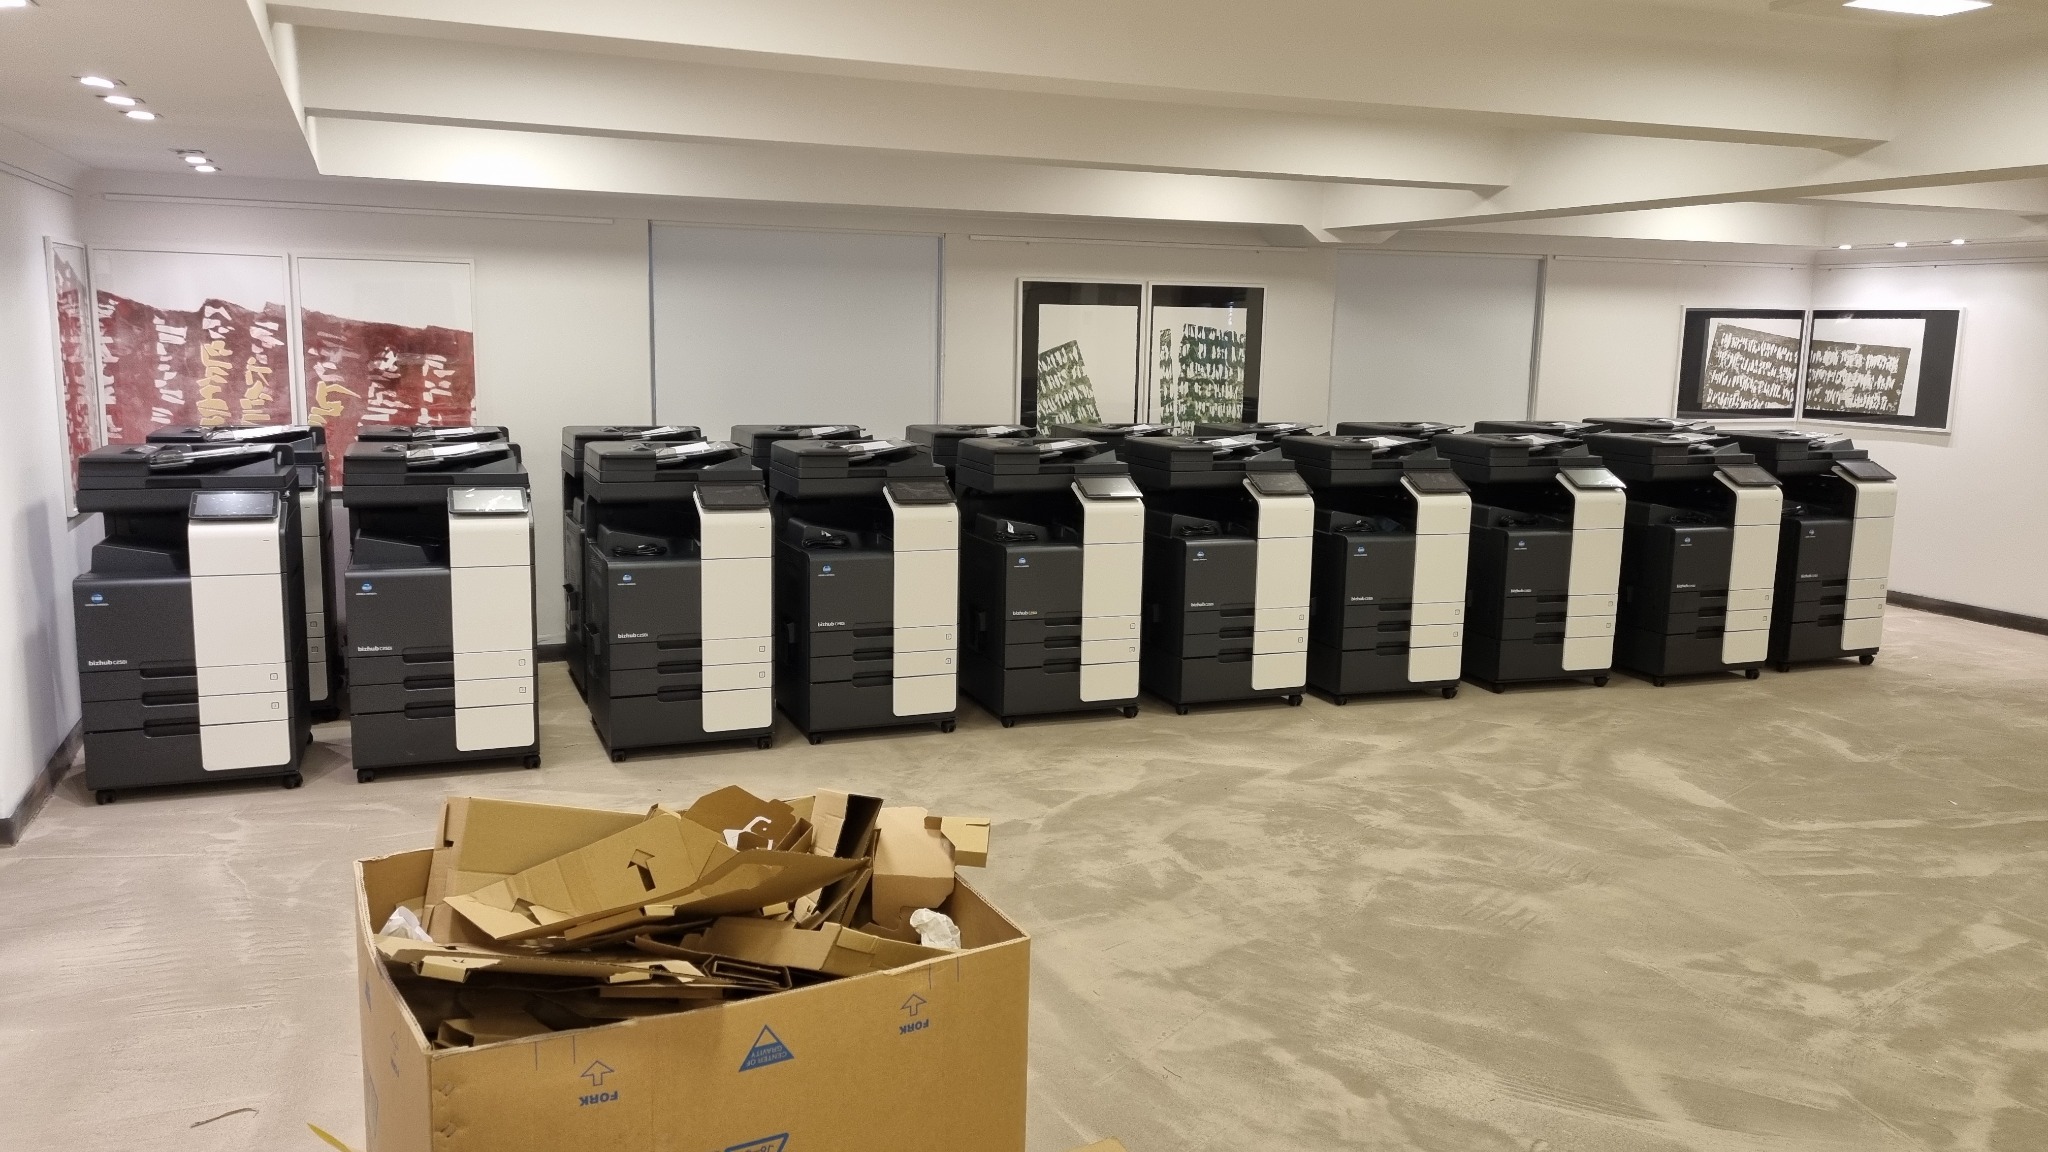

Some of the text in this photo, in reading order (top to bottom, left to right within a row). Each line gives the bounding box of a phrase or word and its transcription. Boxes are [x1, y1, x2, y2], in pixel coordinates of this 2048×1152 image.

[899, 1018, 929, 1035] FORK
[746, 1051, 788, 1067] CENTER OF
[751, 1045, 783, 1058] GRAVITY
[579, 1090, 618, 1107] FORK
